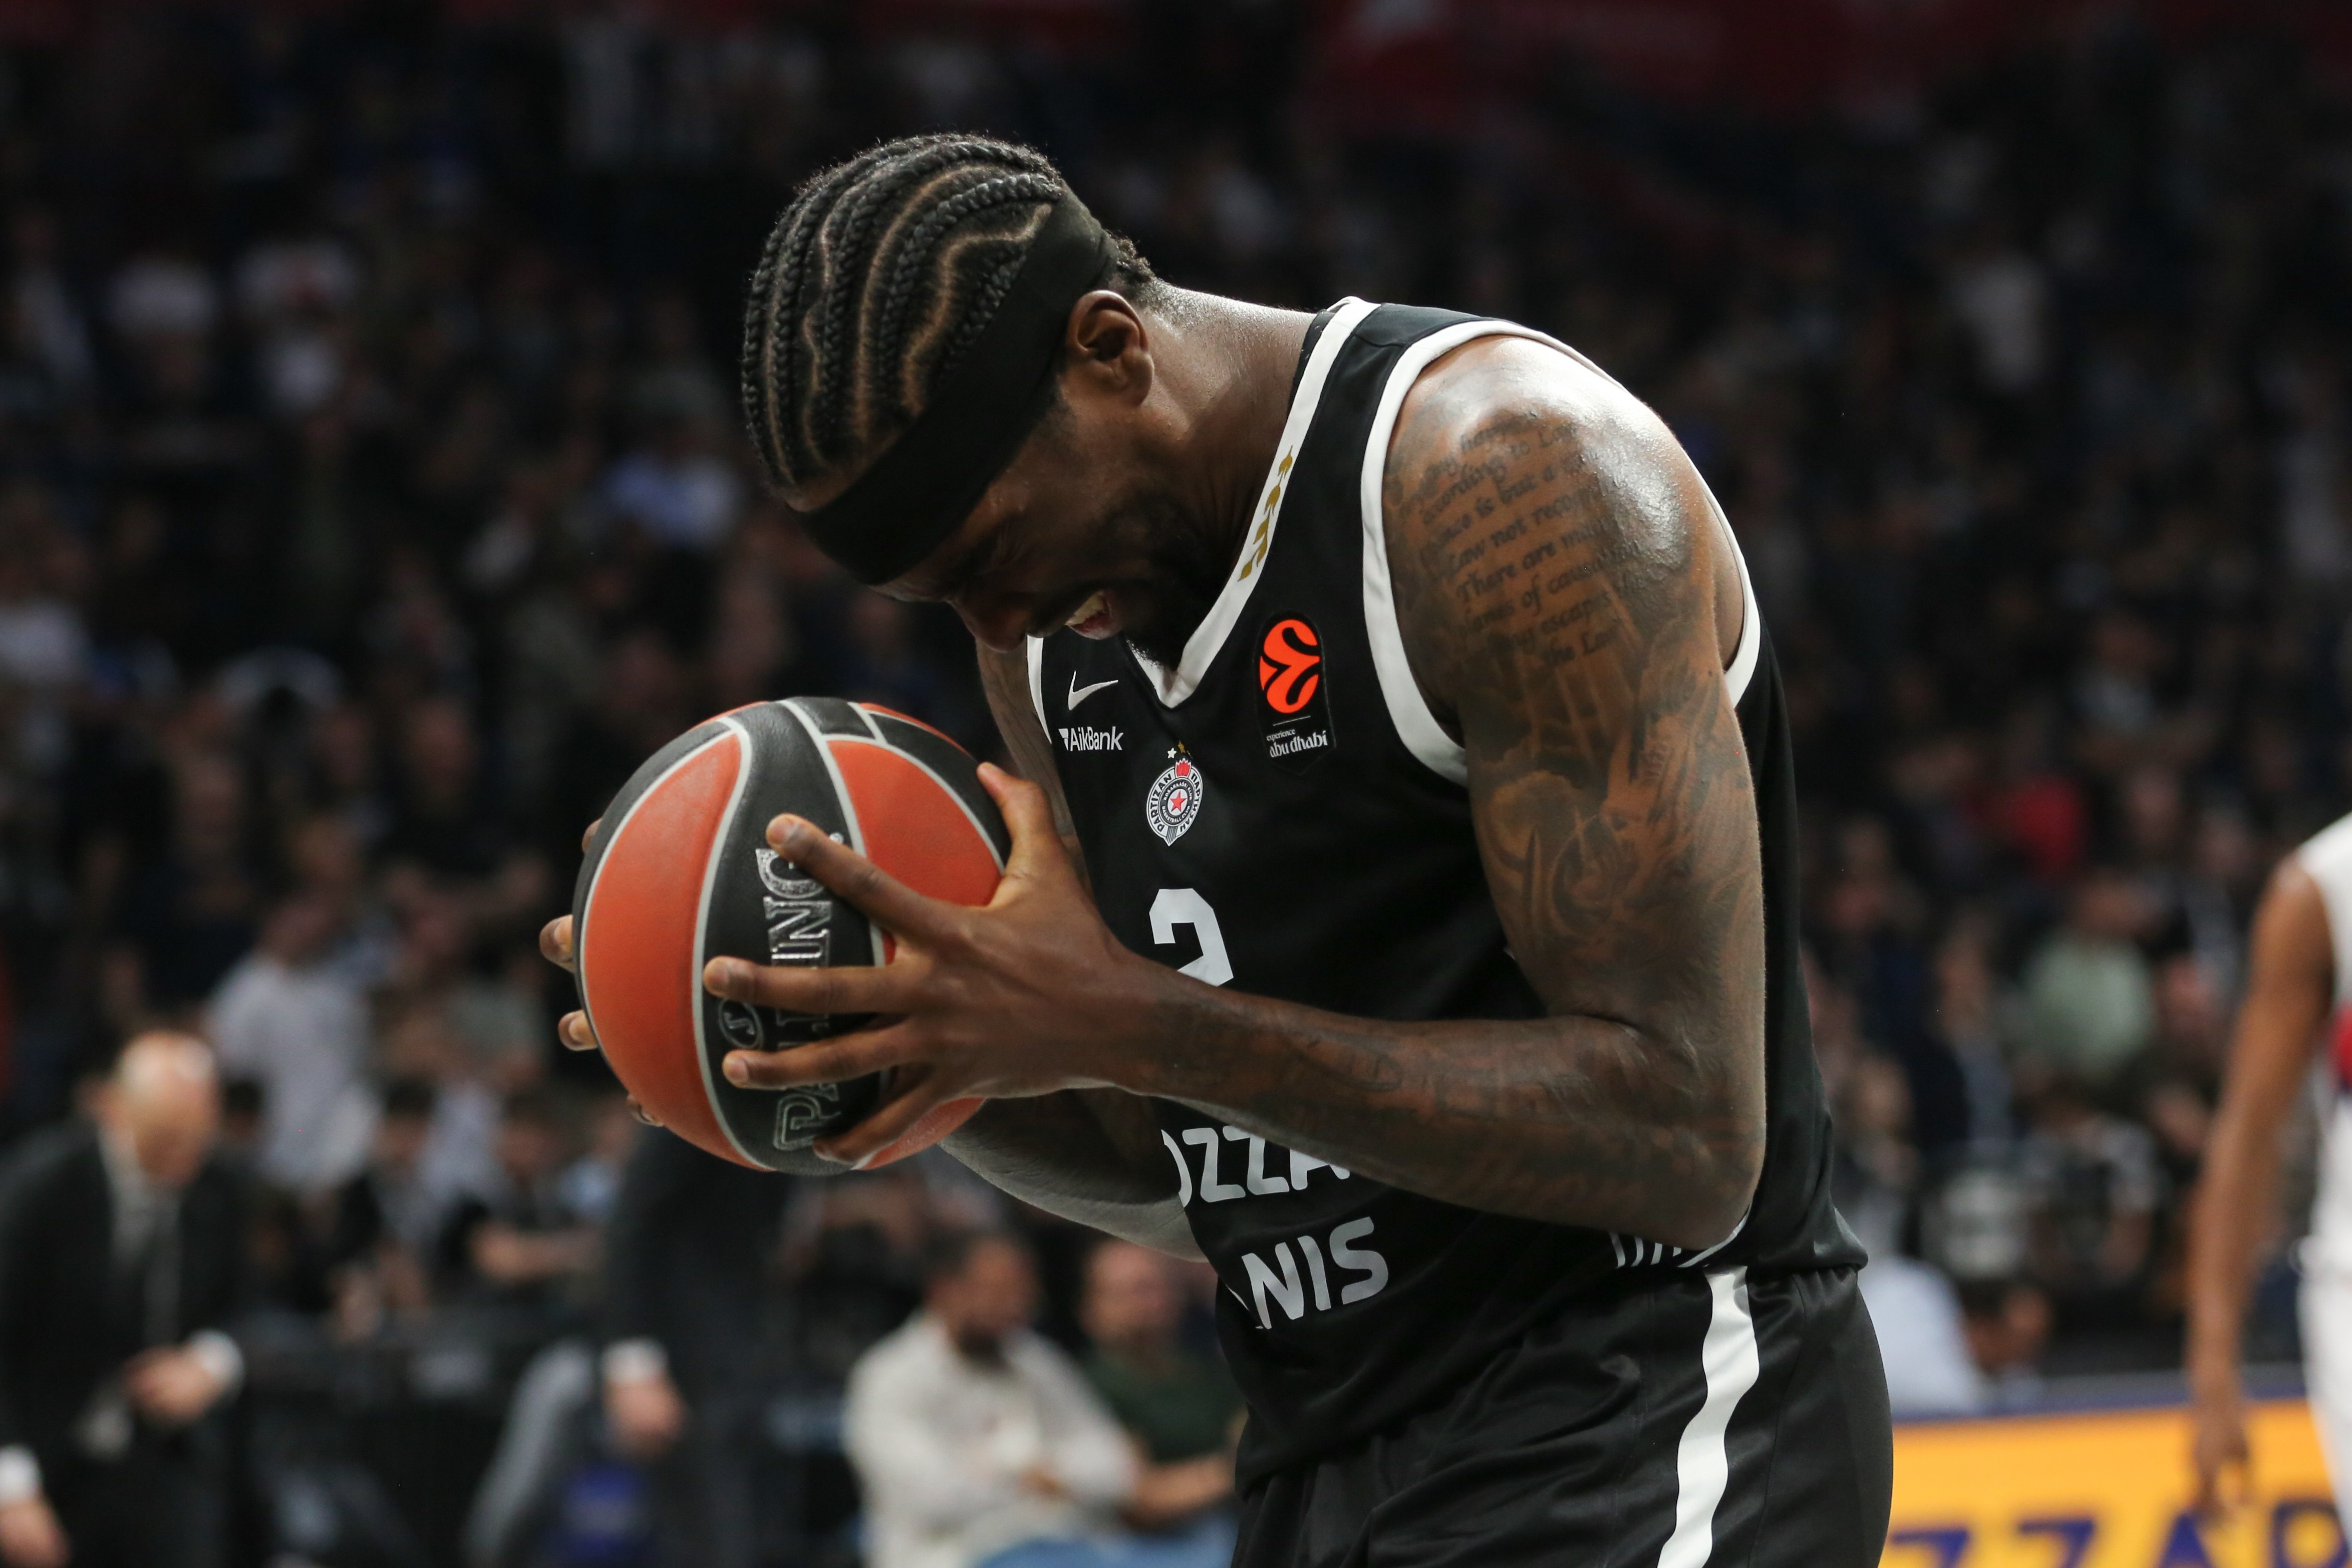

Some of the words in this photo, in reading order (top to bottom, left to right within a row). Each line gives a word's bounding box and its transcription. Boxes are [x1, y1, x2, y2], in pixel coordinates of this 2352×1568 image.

[1456, 563, 1516, 603] There
[1523, 541, 1557, 570] are
[1522, 574, 1543, 616] of
[1070, 726, 1123, 751] AikBank
[1266, 729, 1296, 742] experience
[1270, 742, 1290, 758] abu
[1150, 773, 1172, 832] PARTIZAN
[1161, 805, 1181, 823] BASKETBALL
[1241, 1216, 1389, 1330] NIS
